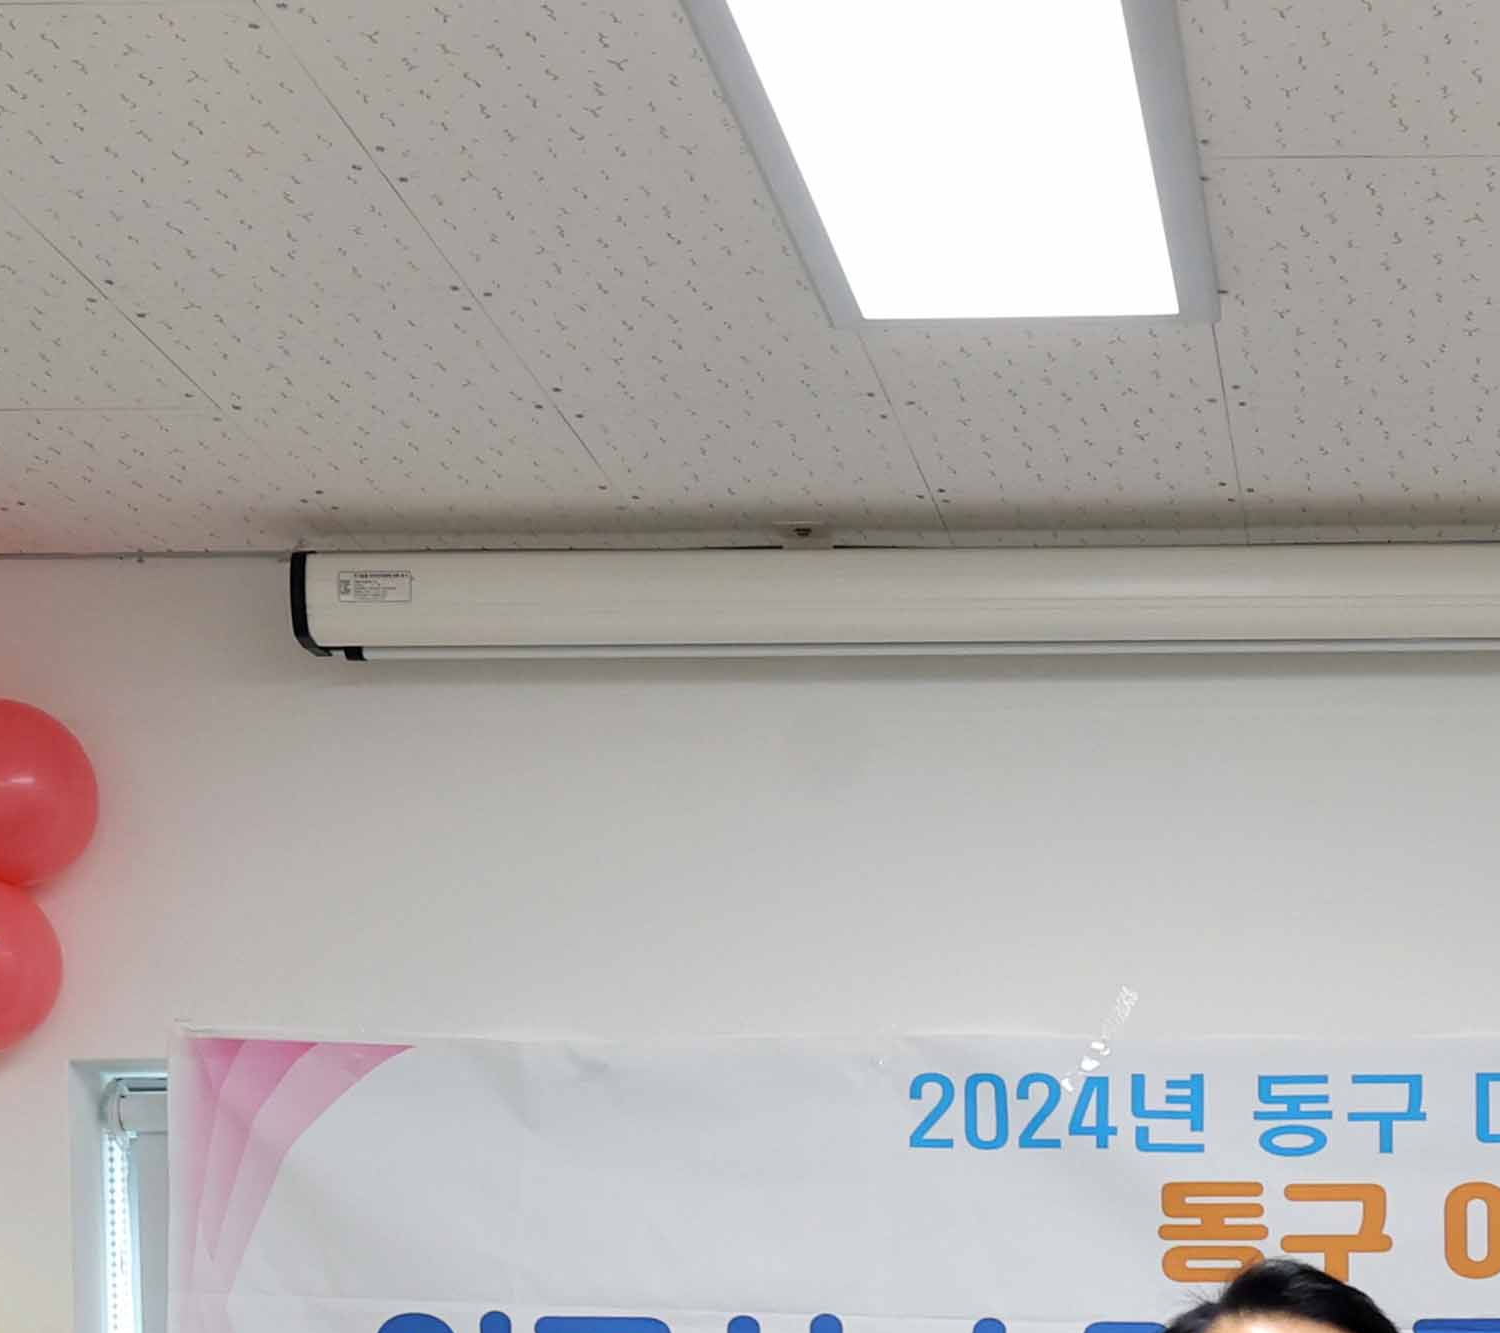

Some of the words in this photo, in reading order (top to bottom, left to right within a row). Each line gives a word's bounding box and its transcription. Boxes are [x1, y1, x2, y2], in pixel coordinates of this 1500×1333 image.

[908, 1071, 1206, 1154] 2024년
[1252, 1071, 1428, 1157] 동구
[1158, 1180, 1393, 1283] 동구
